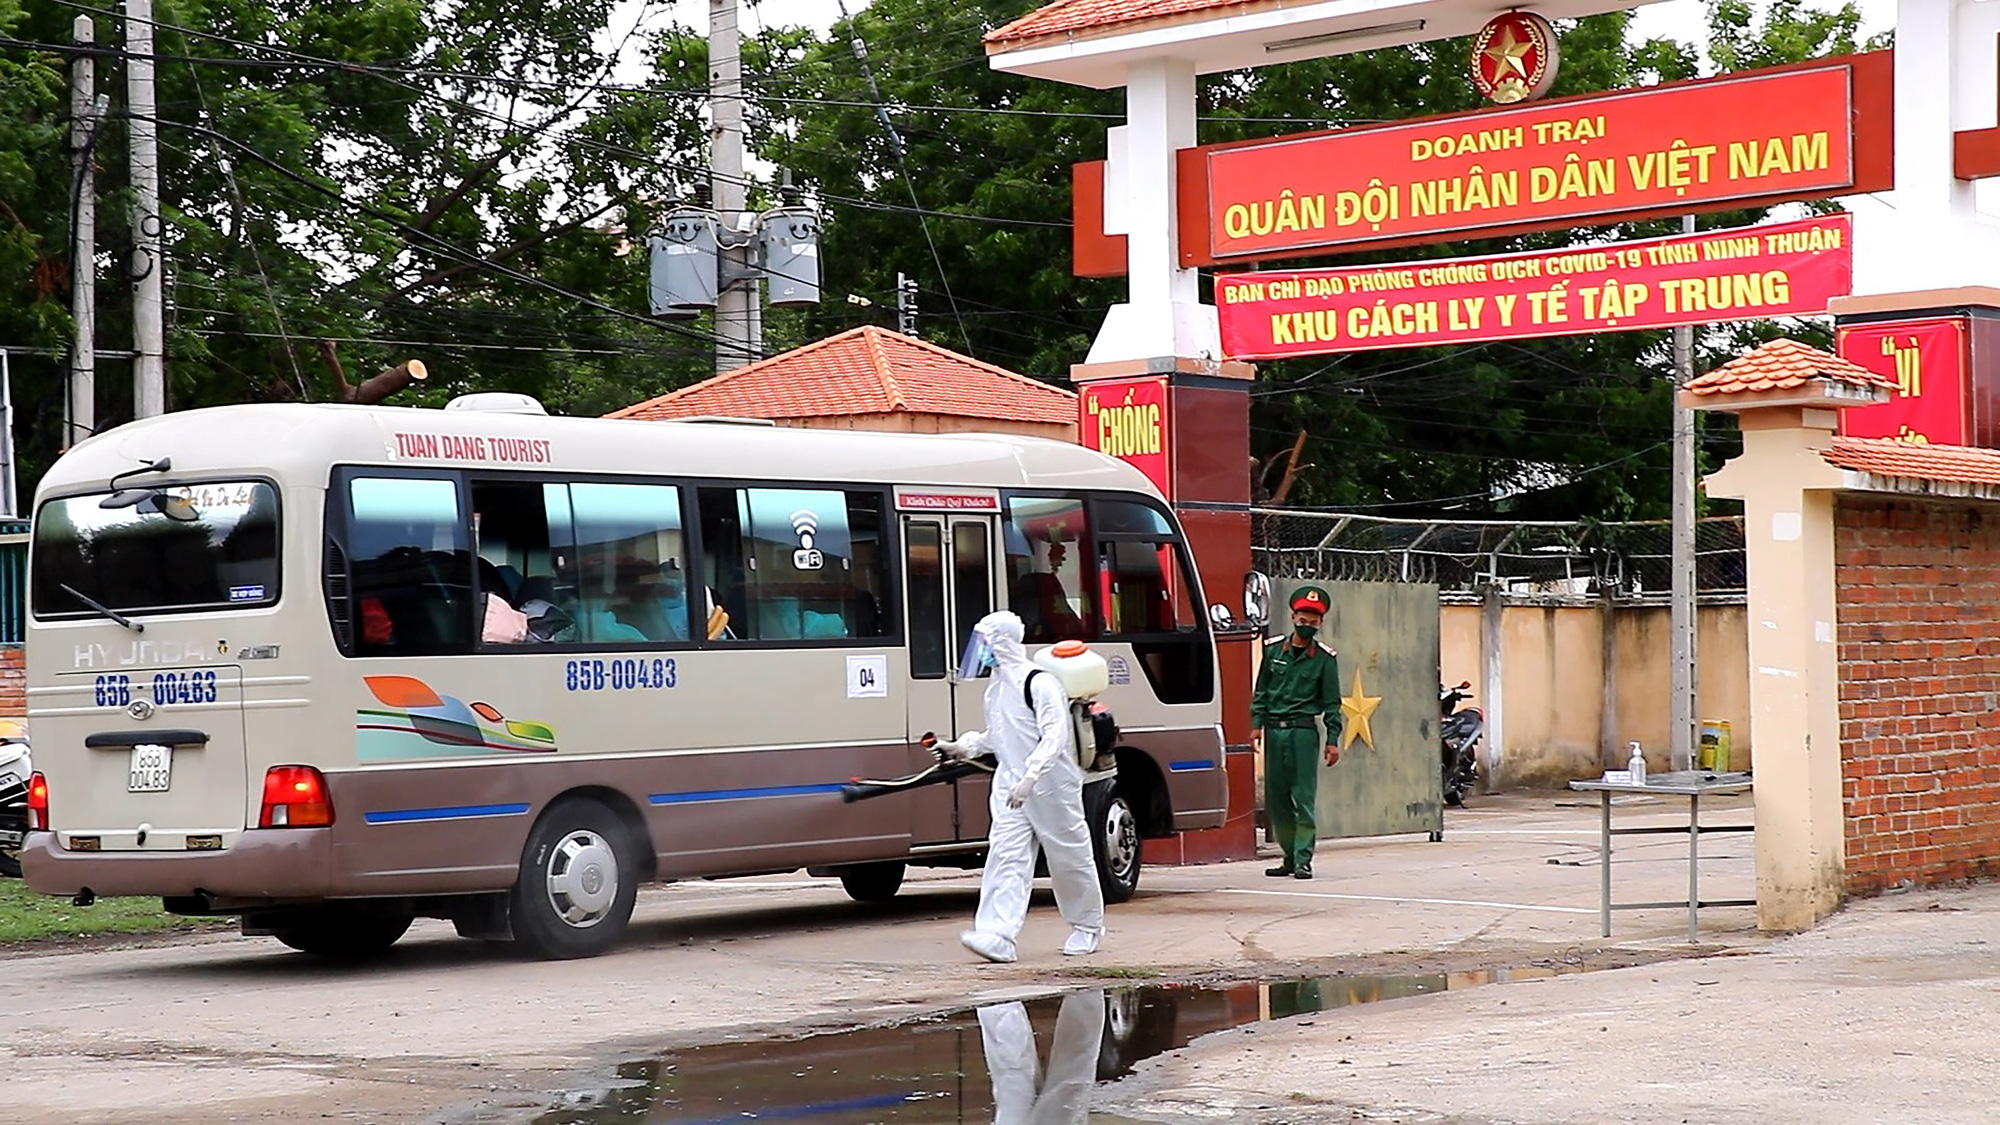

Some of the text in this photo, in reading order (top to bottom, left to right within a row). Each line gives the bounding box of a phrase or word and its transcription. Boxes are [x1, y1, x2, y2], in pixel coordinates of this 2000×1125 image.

[1411, 116, 1606, 161] DOANH TRẠI
[1224, 131, 1828, 239] QUÂN ĐỘI NHÂN DÂN VIỆT NAM
[1224, 283, 1265, 304] BAN
[1304, 276, 1345, 300] ĐẠO
[1349, 269, 1415, 293] PHÒNG
[1492, 258, 1541, 283] DỊCH
[1545, 249, 1642, 276] COVID-19
[1703, 236, 1760, 261] NINH
[1765, 226, 1841, 255] THUẬN
[1271, 270, 1790, 345] KHU CÁCH LY Y TẾ TẬP TRUNG
[395, 433, 552, 463] TUAN DANG TOURIST
[75, 640, 213, 668] HYUNDA
[566, 658, 676, 691] 85B-004.83
[860, 668, 875, 687] 04
